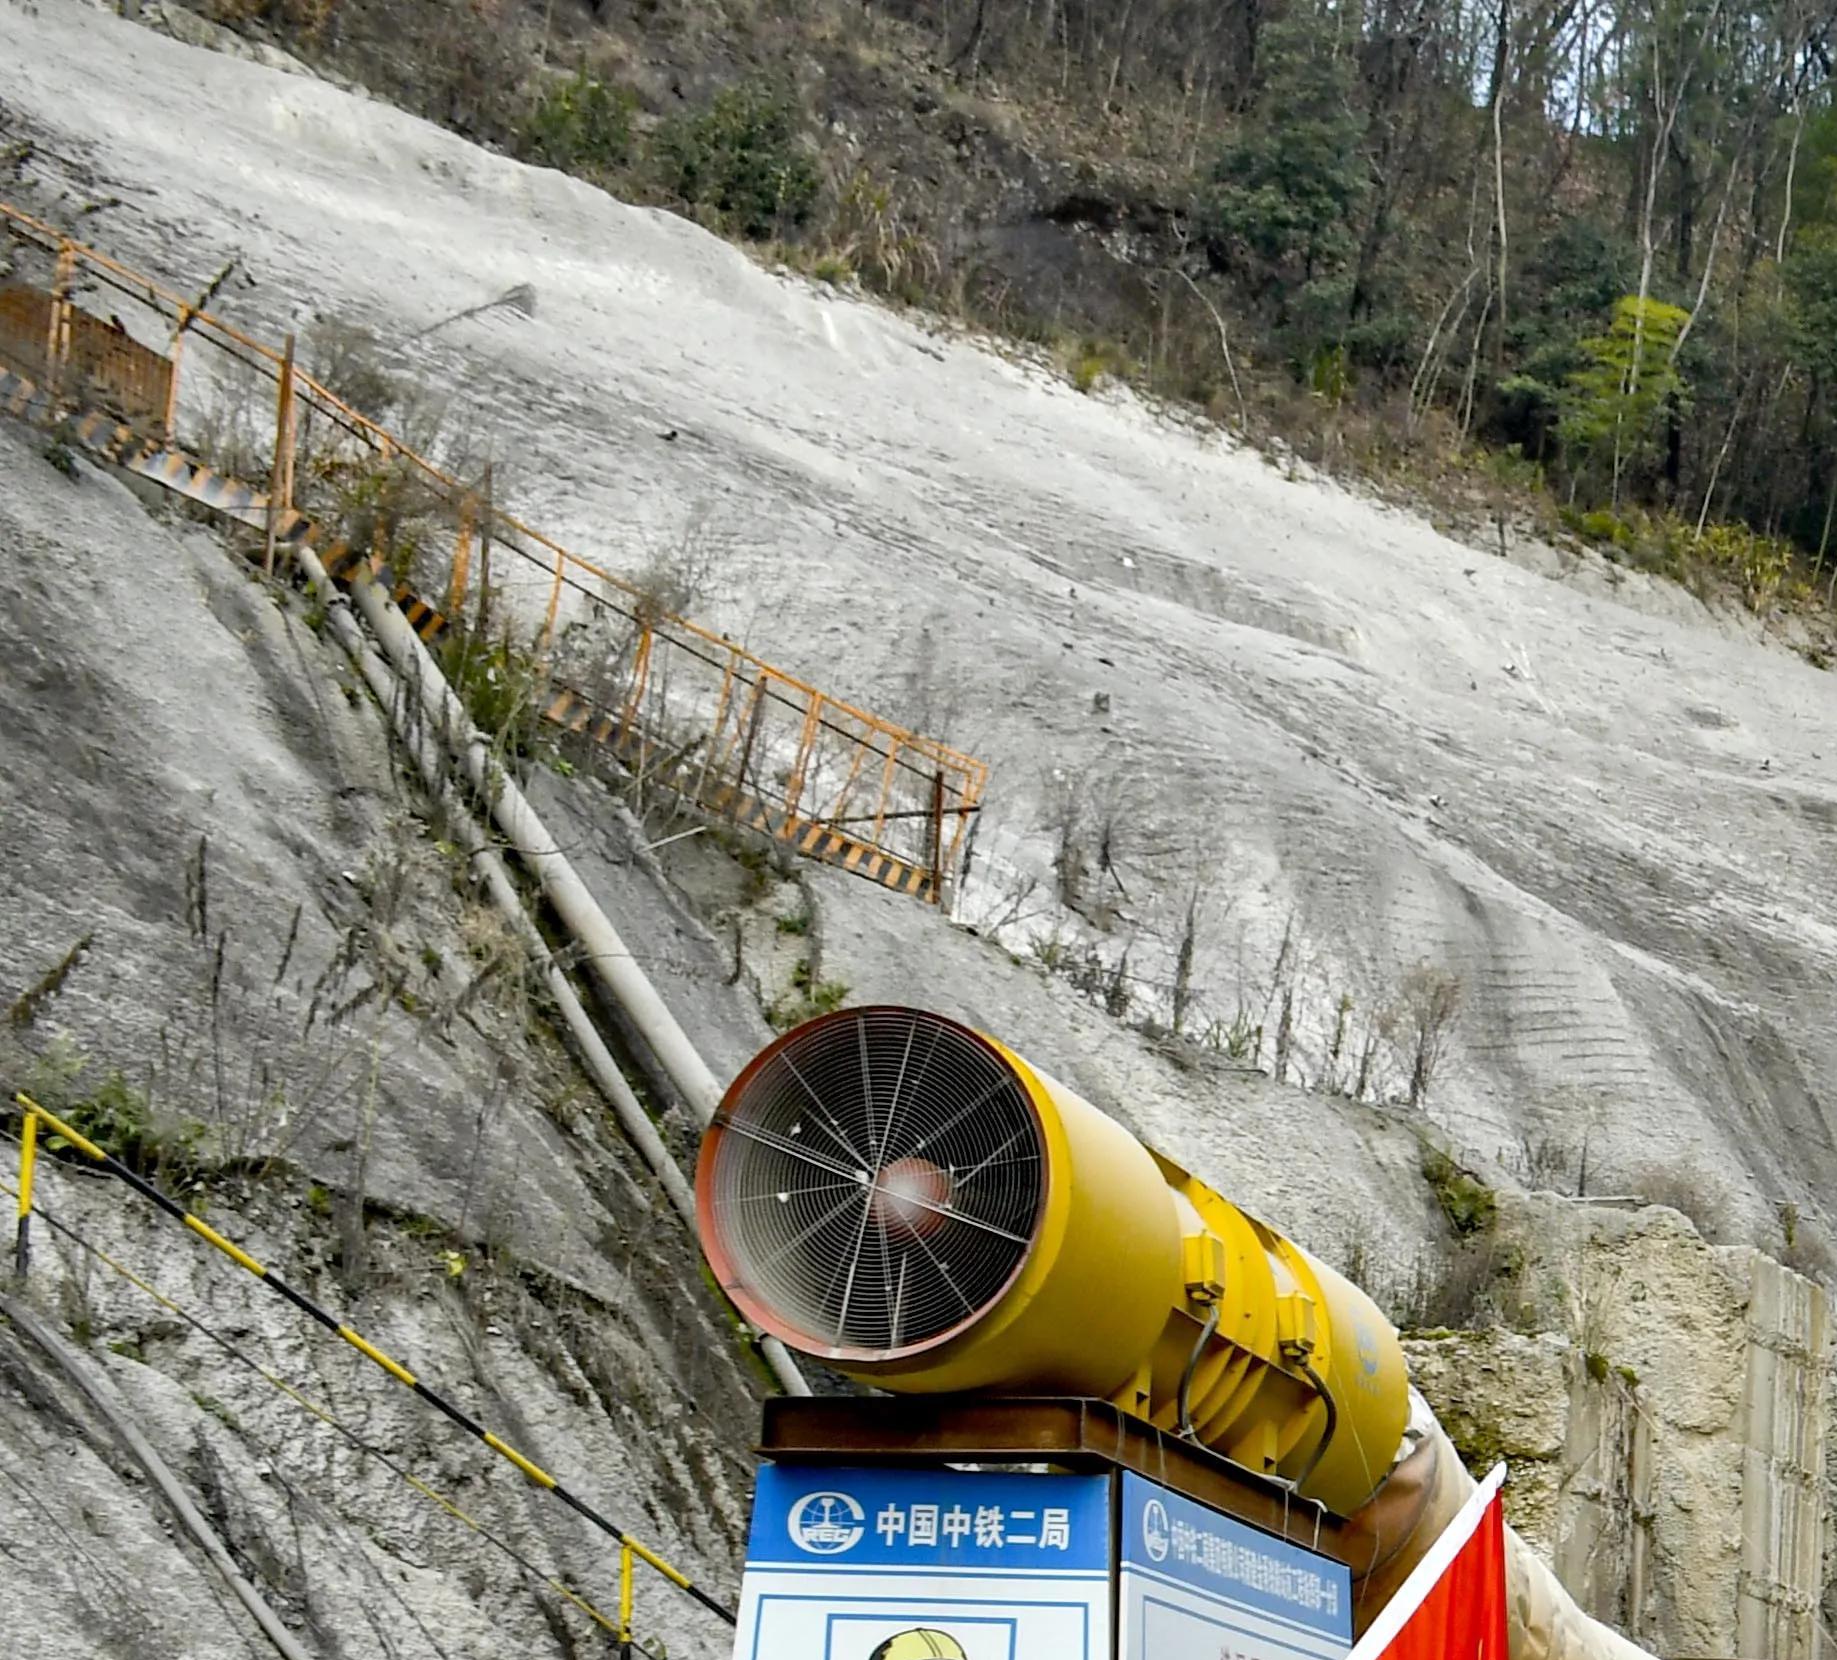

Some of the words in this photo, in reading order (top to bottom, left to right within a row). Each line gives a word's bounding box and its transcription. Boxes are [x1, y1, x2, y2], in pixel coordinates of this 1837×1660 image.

[876, 1502, 1070, 1551] 中国中铁二局
